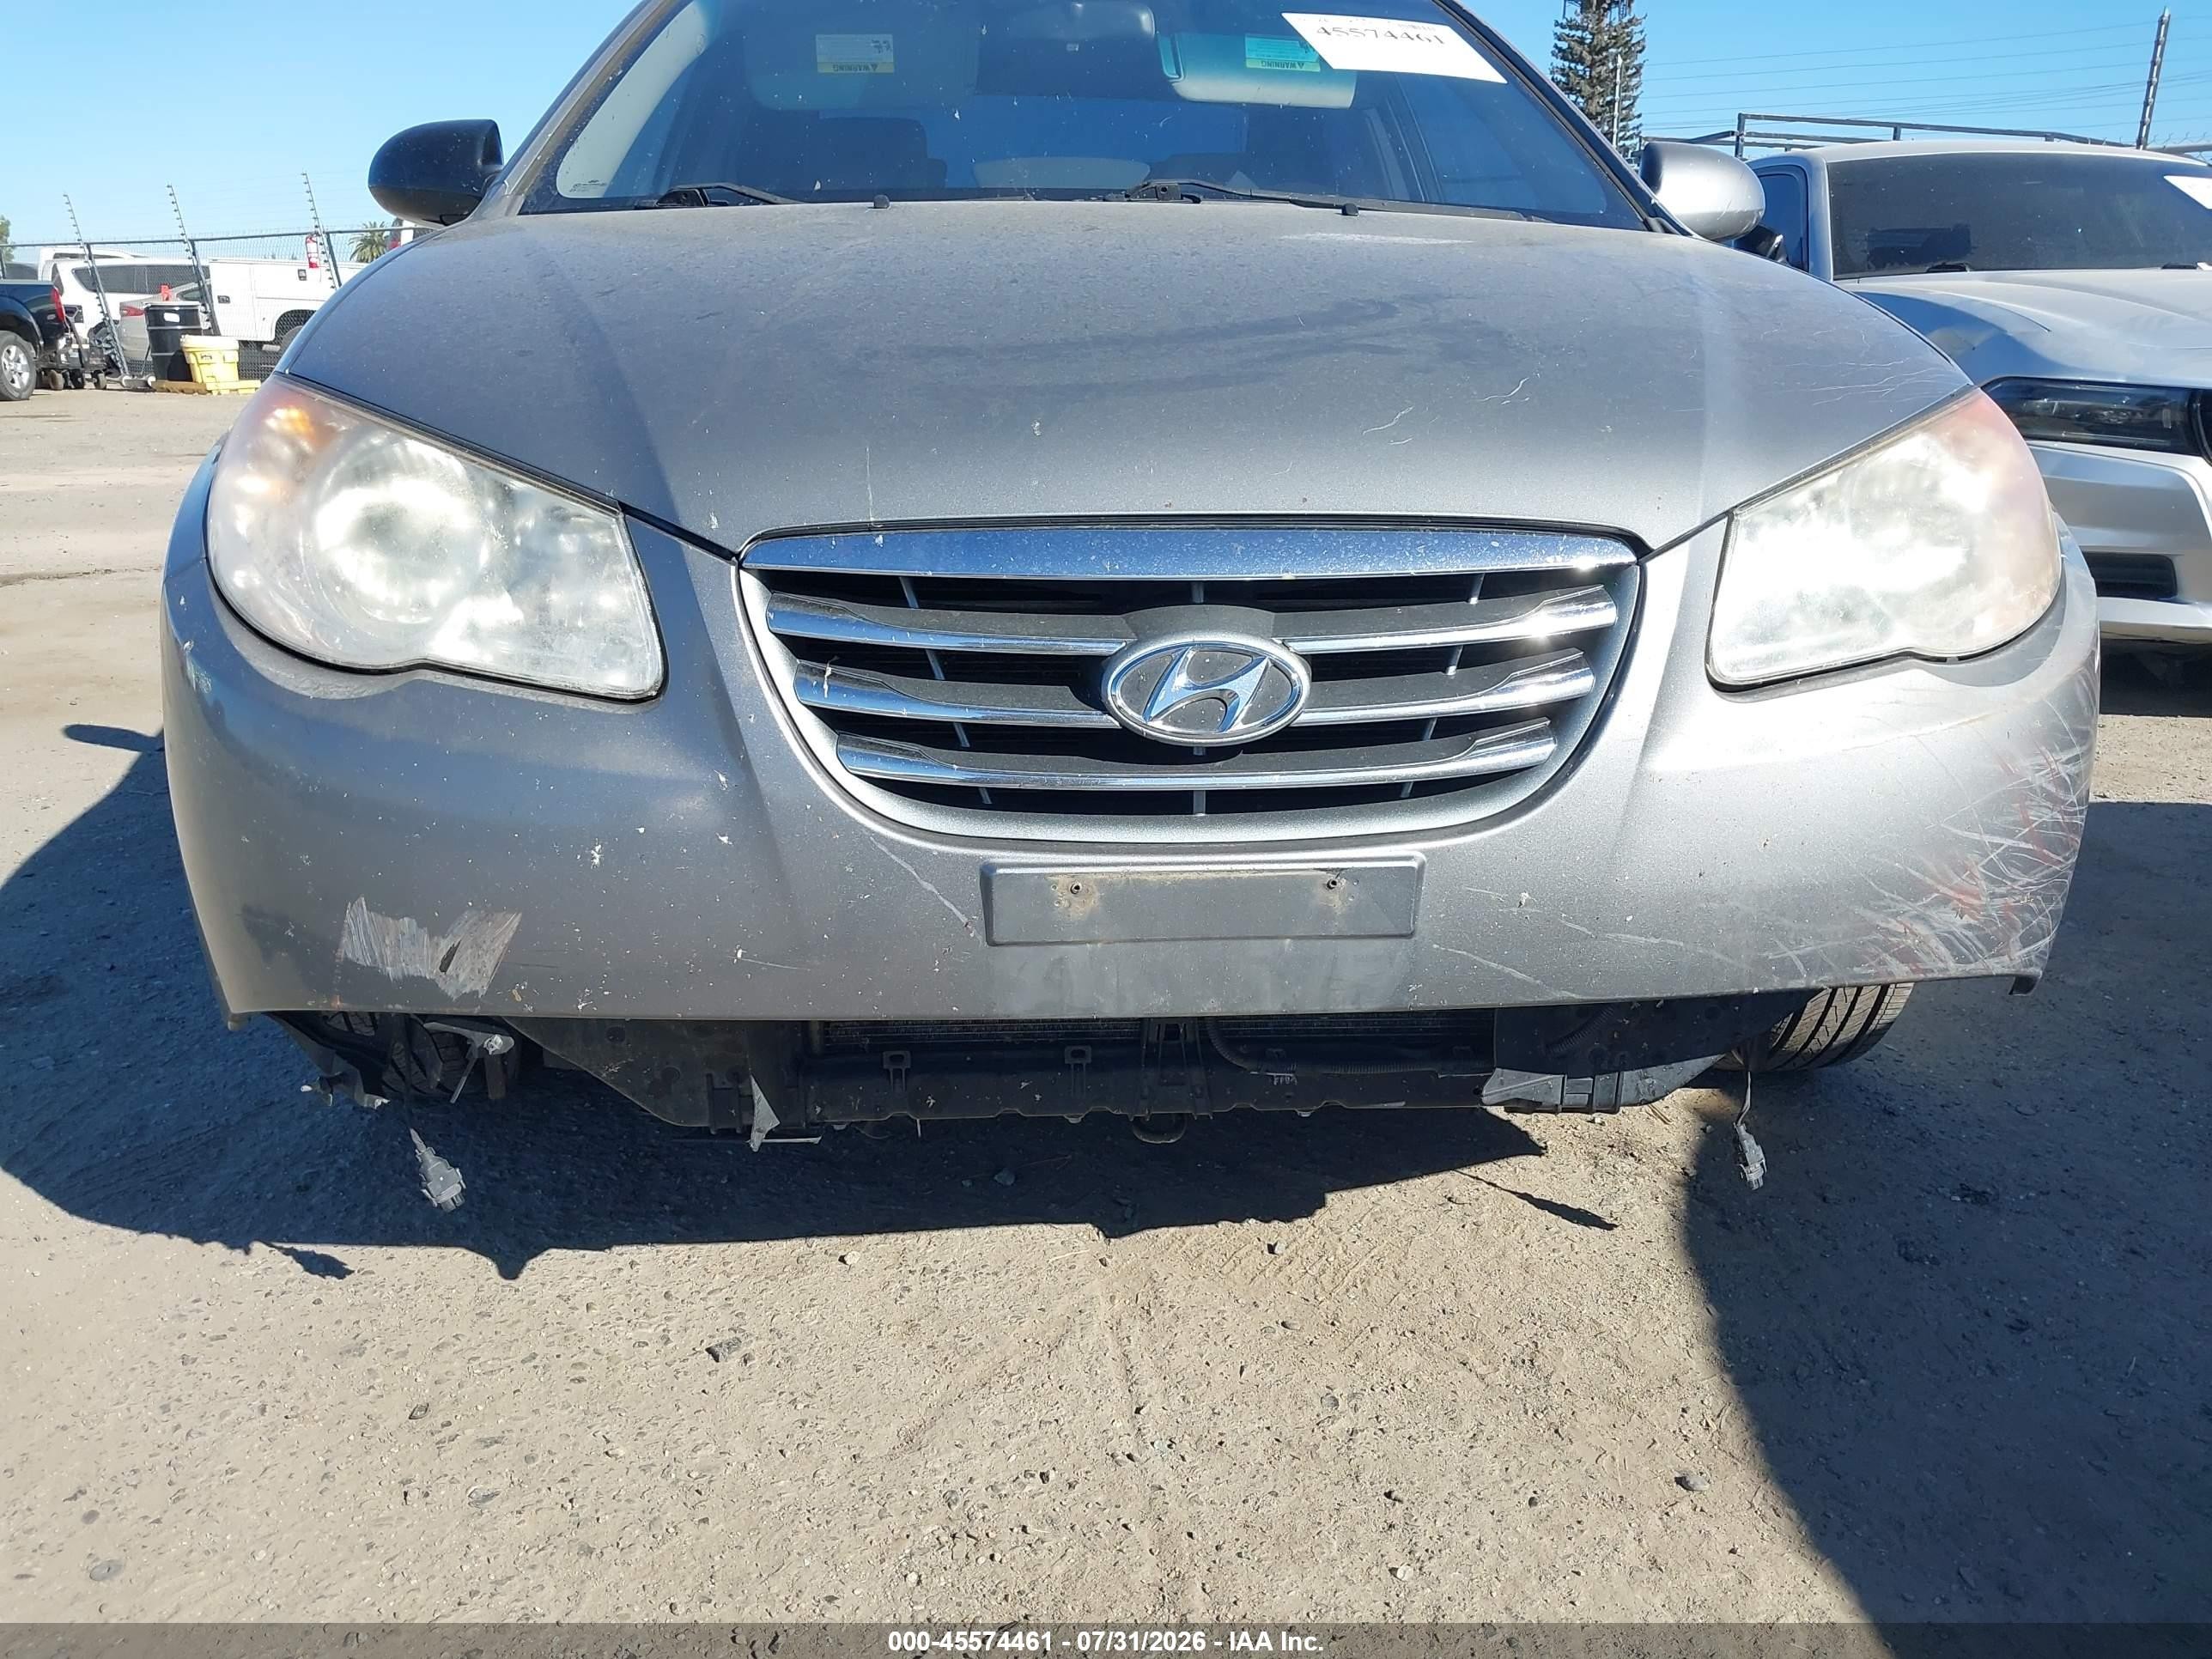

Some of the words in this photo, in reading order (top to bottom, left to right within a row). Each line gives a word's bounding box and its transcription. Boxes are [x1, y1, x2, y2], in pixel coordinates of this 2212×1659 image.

[1316, 26, 1445, 44] 45574461
[833, 64, 870, 72] WARNING
[1261, 60, 1297, 69] WARNING
